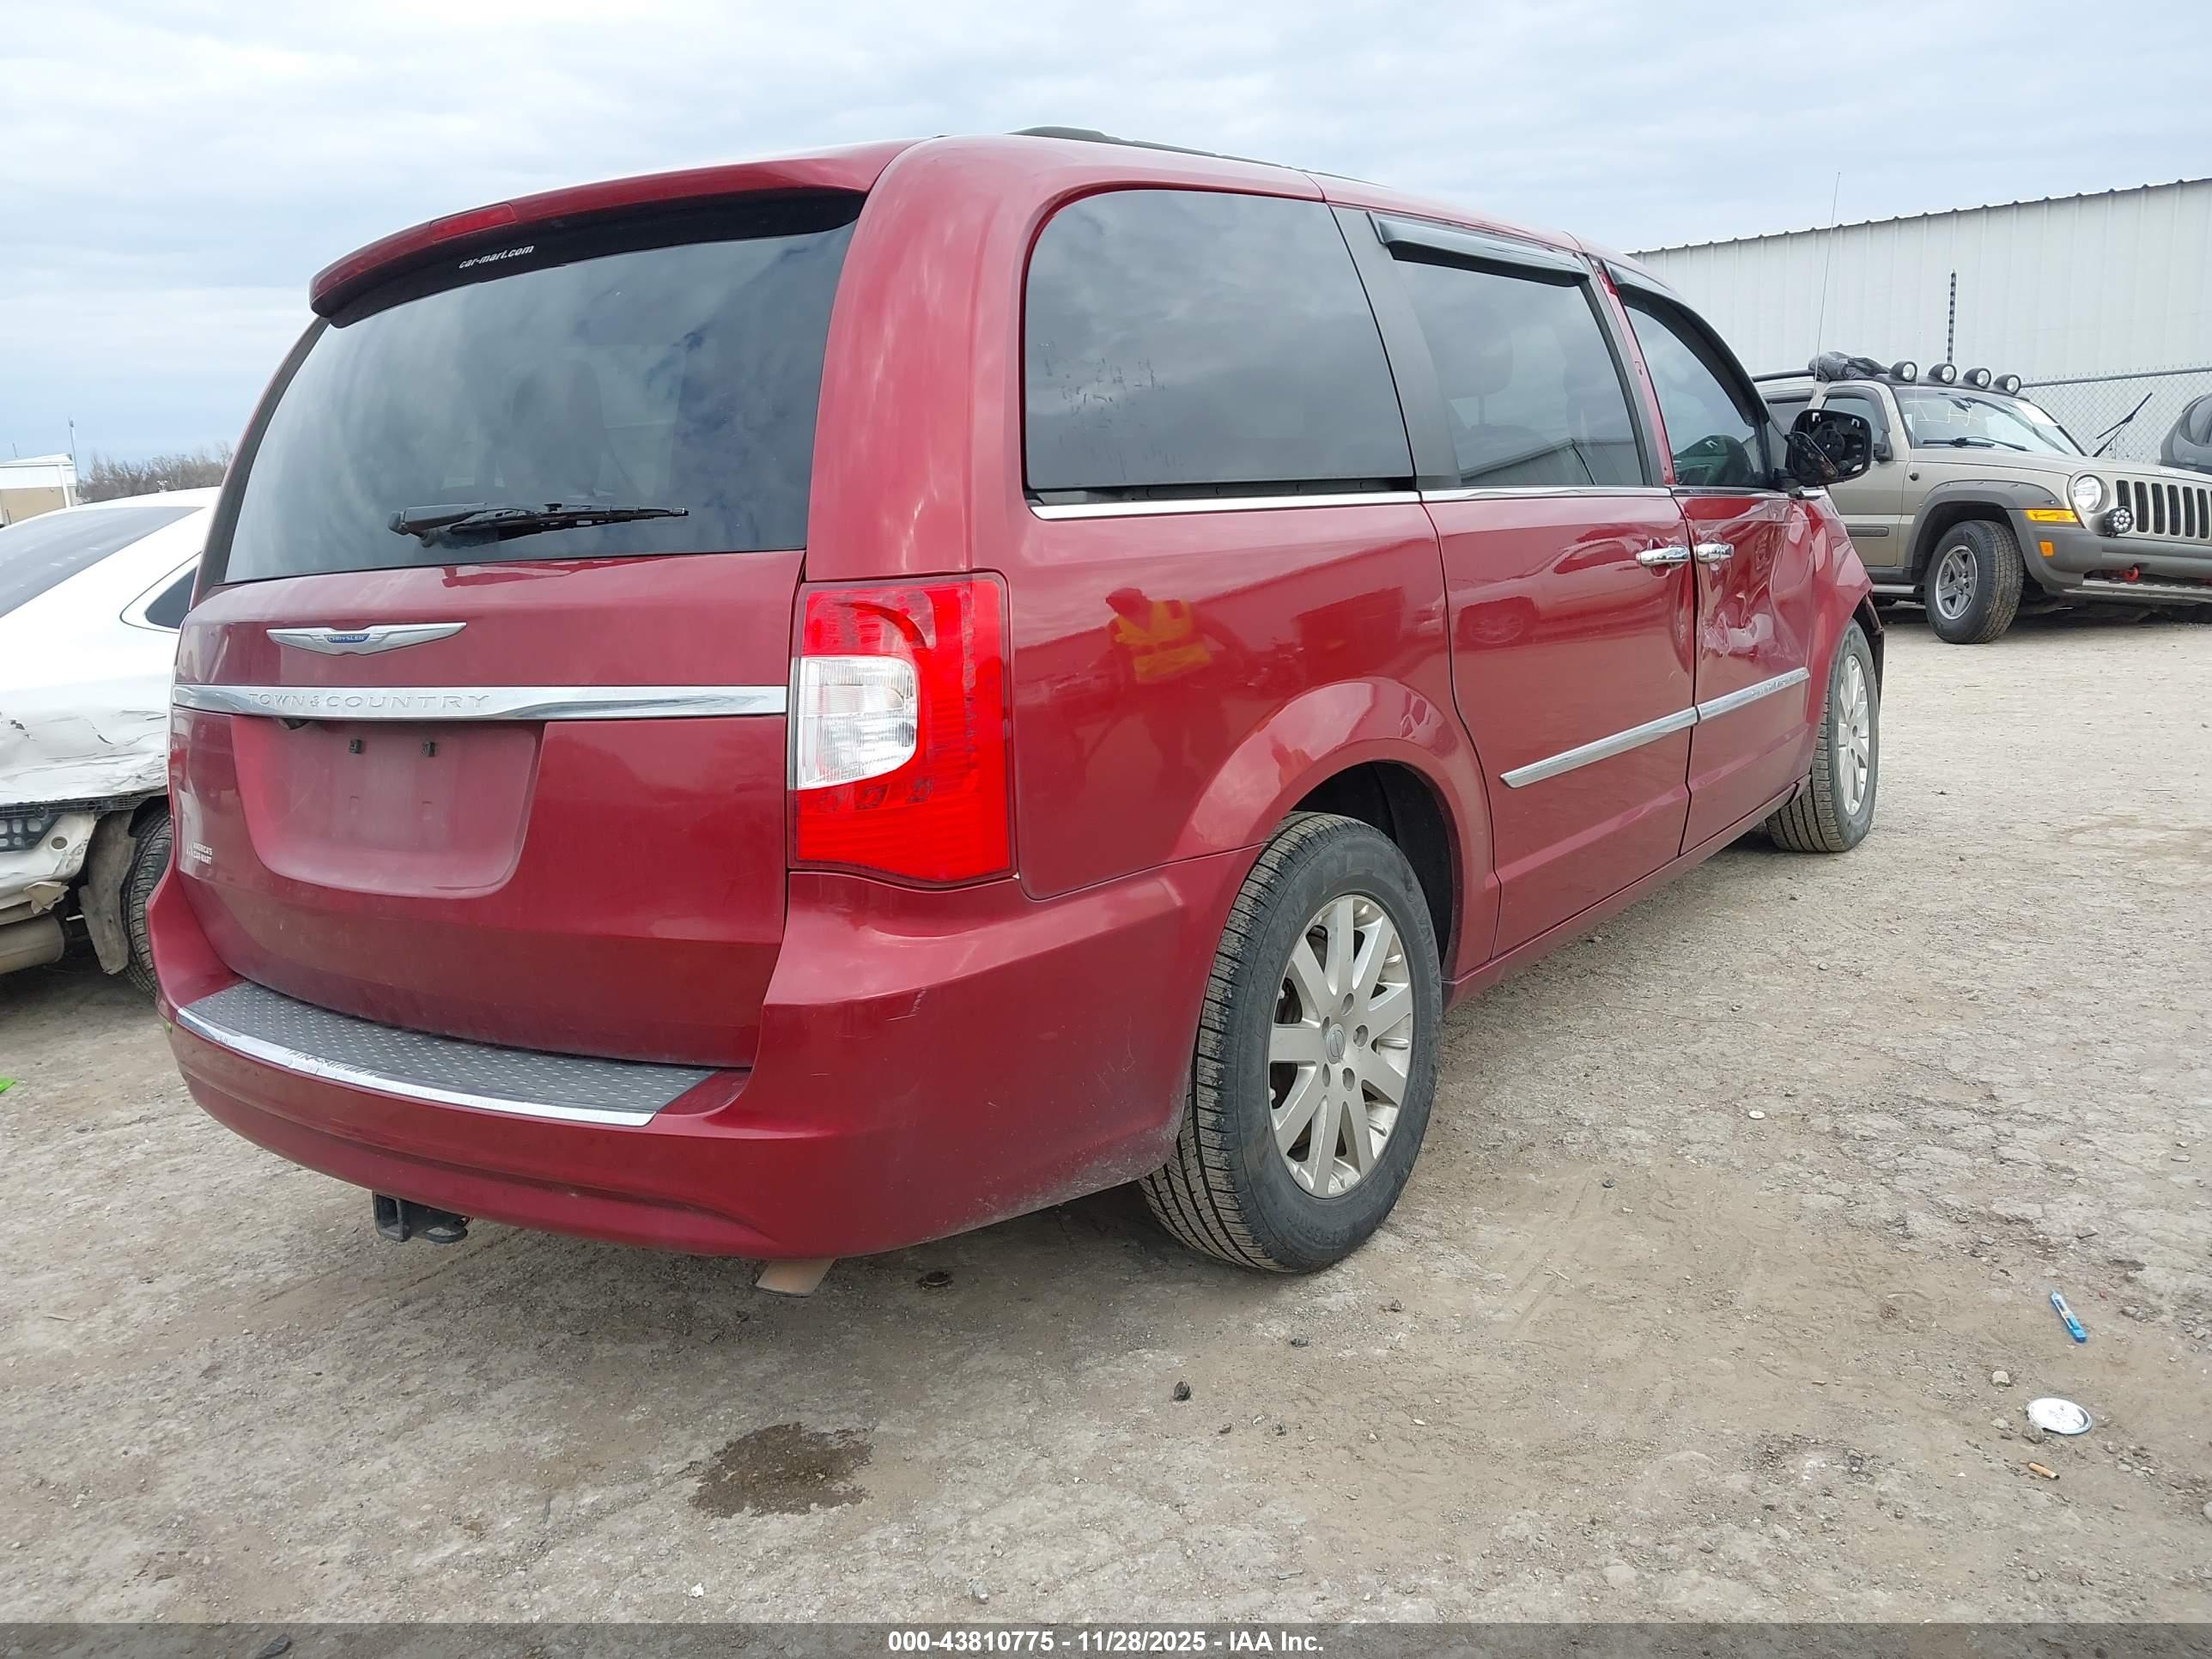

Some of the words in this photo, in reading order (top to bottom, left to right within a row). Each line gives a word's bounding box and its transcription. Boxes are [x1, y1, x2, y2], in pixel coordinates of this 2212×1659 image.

[459, 245, 535, 269] car-mart.com
[247, 693, 304, 705] TOWN
[325, 695, 490, 708] COUNTRY
